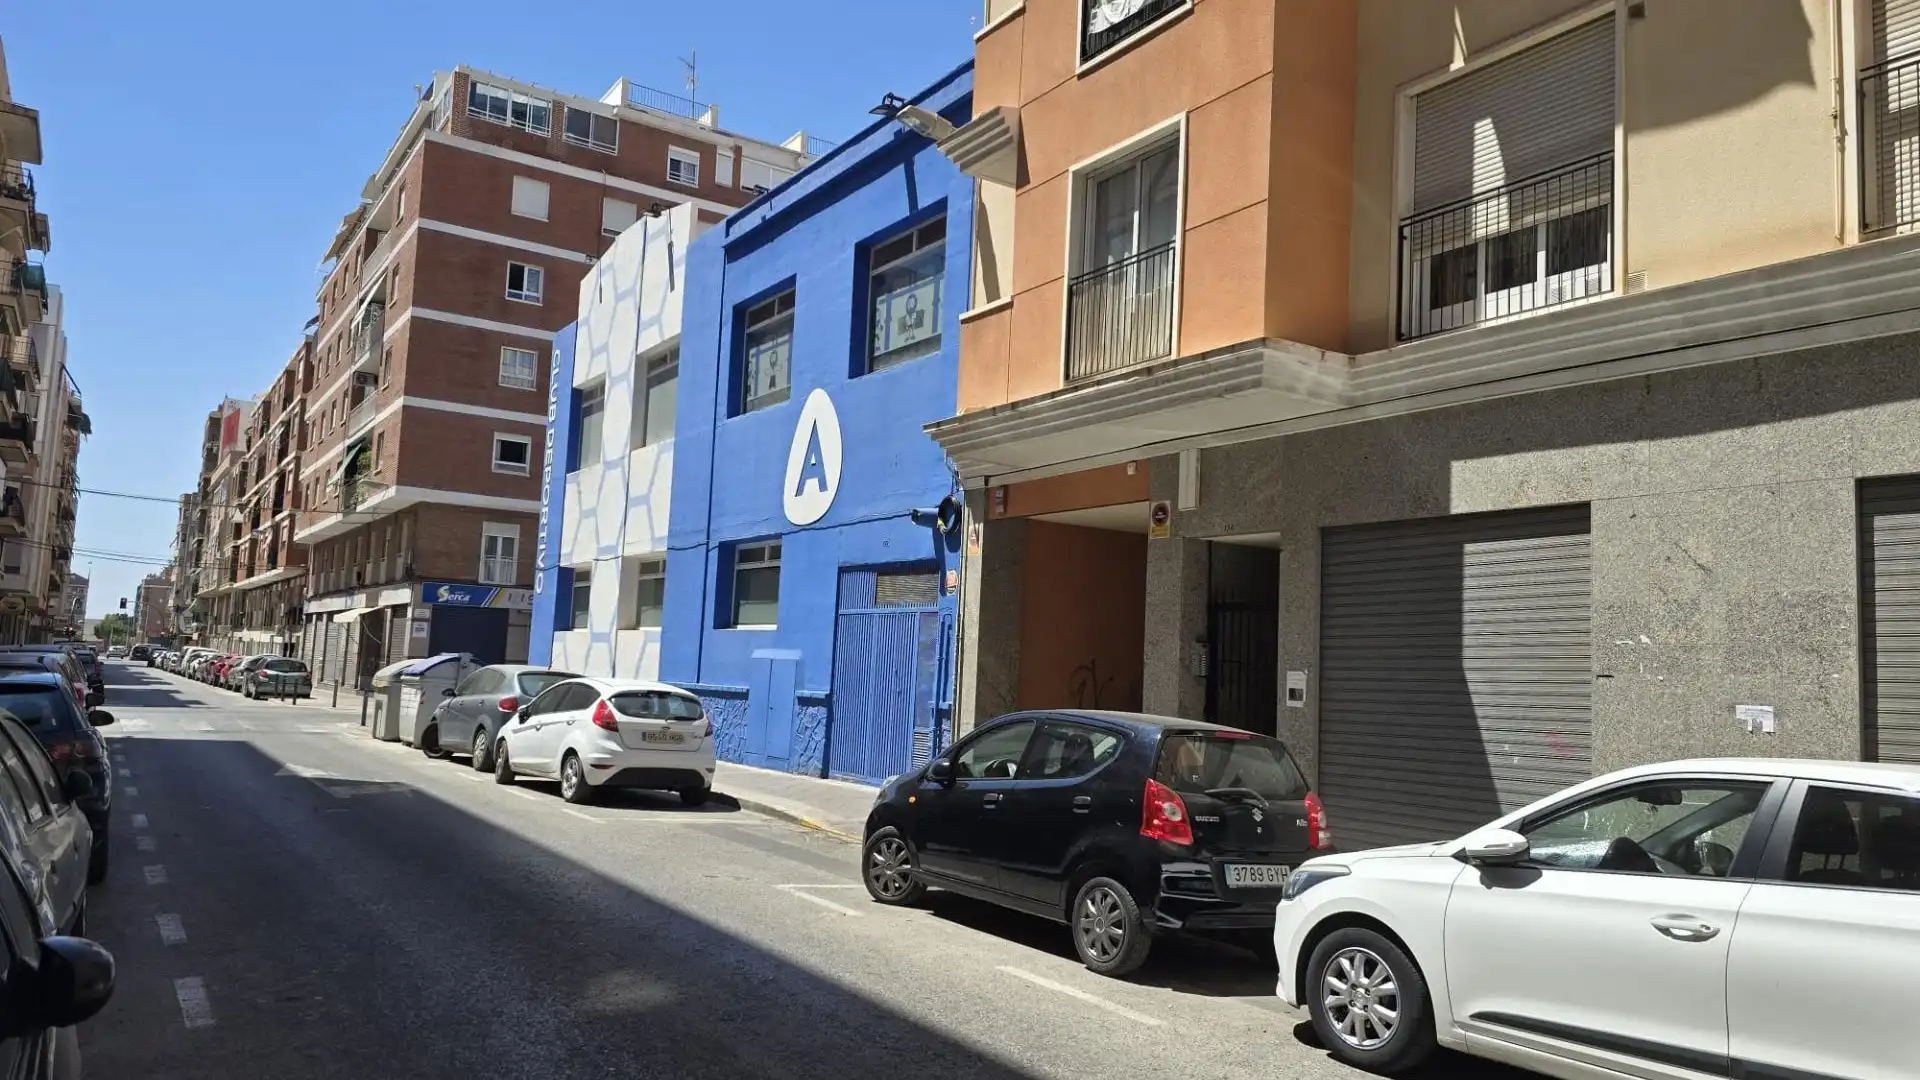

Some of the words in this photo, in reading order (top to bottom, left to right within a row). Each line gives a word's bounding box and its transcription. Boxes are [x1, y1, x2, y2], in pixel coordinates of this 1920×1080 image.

[547, 349, 561, 423] CLUB
[794, 417, 829, 498] A
[534, 428, 555, 595] DEPORTIVO
[437, 585, 472, 602] Serca
[1233, 866, 1264, 882] 3789
[1266, 867, 1288, 882] GYH
